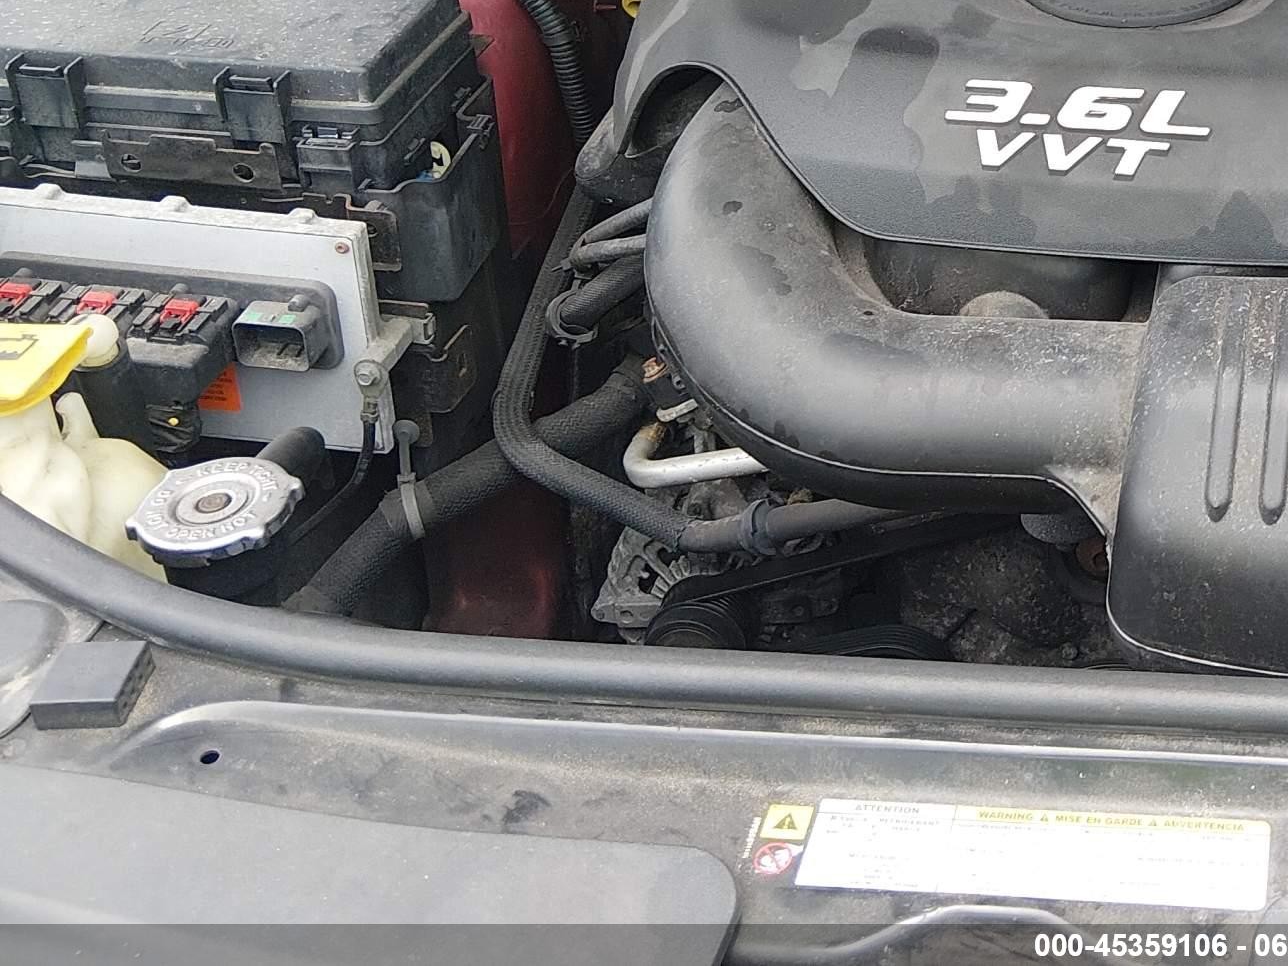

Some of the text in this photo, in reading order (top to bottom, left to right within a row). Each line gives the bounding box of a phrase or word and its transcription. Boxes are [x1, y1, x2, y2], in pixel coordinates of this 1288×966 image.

[944, 78, 1211, 140] 3.6L
[976, 128, 1171, 180] VVT
[855, 804, 920, 815] ATTENTION
[978, 810, 1034, 821] WARNING
[1055, 814, 1082, 823] MISE
[1086, 816, 1102, 824] EN
[1105, 817, 1143, 827] GARDE
